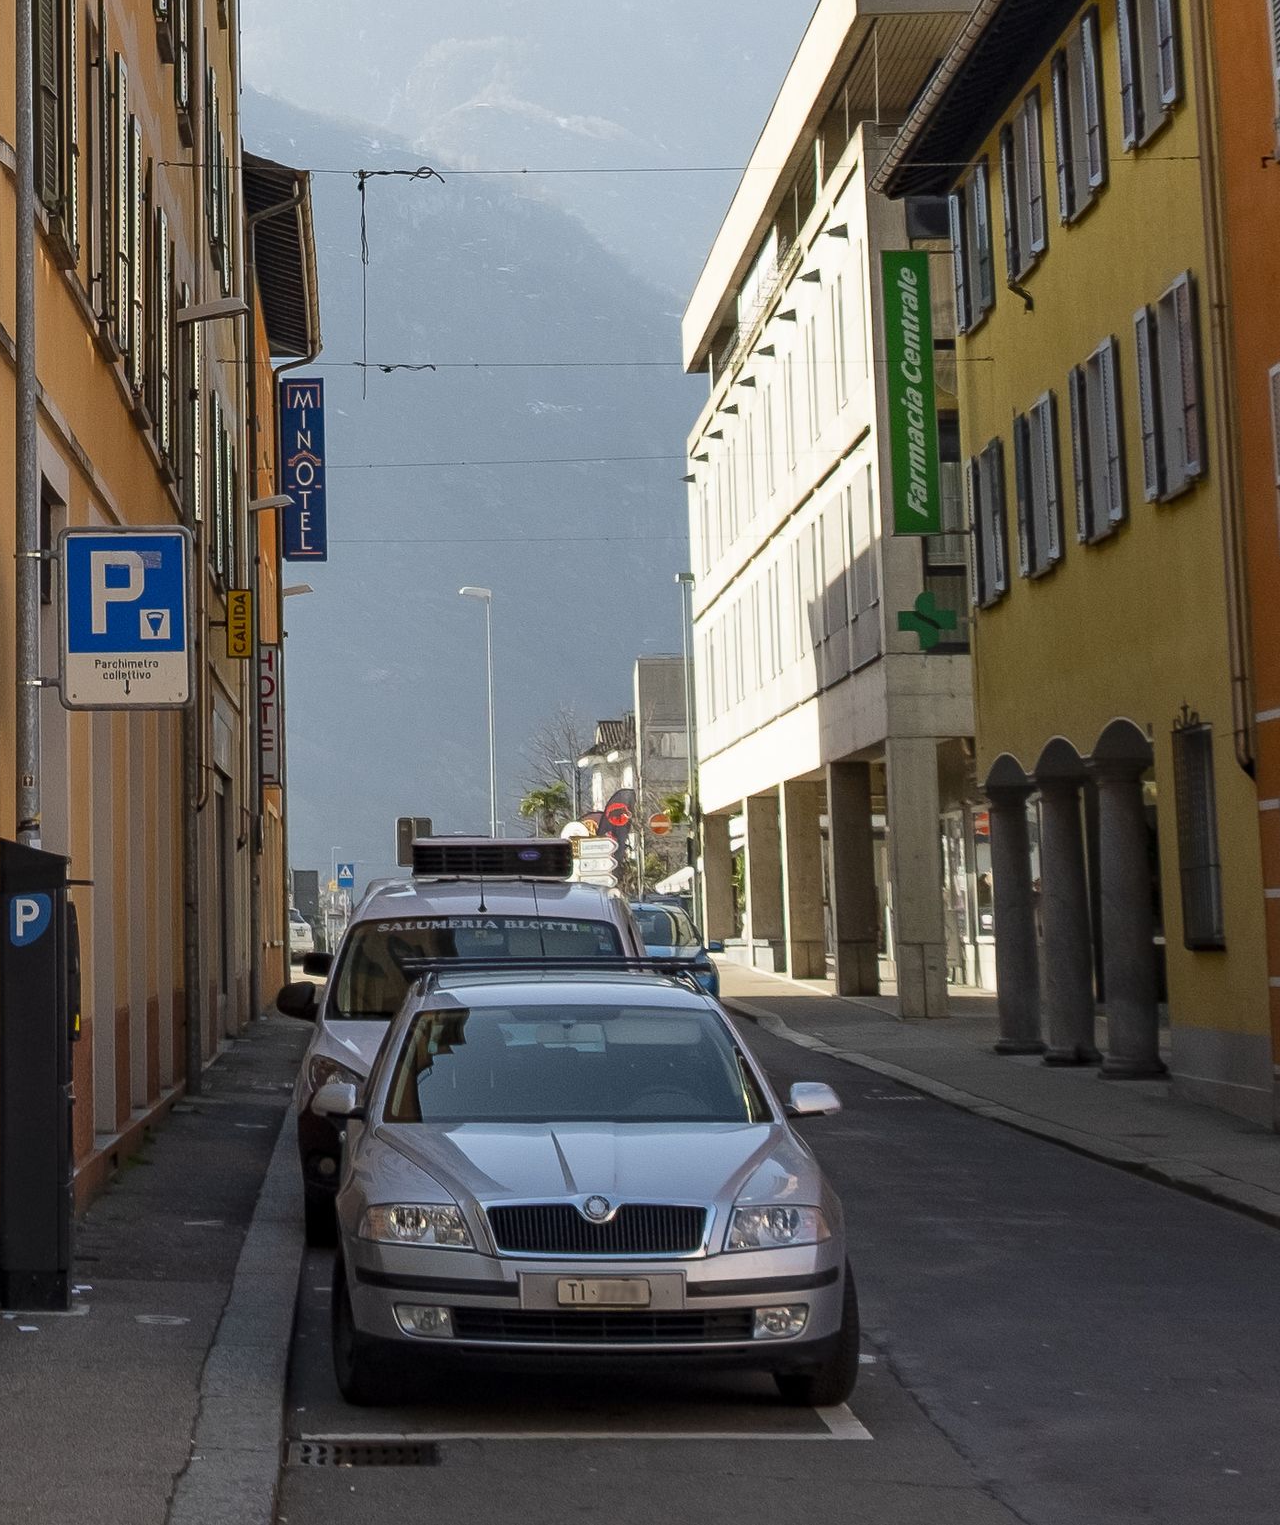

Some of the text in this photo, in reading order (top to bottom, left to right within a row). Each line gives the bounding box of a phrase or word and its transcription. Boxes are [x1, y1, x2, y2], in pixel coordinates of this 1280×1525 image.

[898, 265, 930, 517] Farmacia Centrale
[293, 390, 314, 550] MINOTEL
[90, 550, 145, 635] P
[233, 593, 246, 653] CALIDA
[94, 659, 159, 669] Parchimetro
[102, 670, 152, 680] collettivo
[16, 899, 40, 937] P
[376, 919, 499, 933] SALUMERIA
